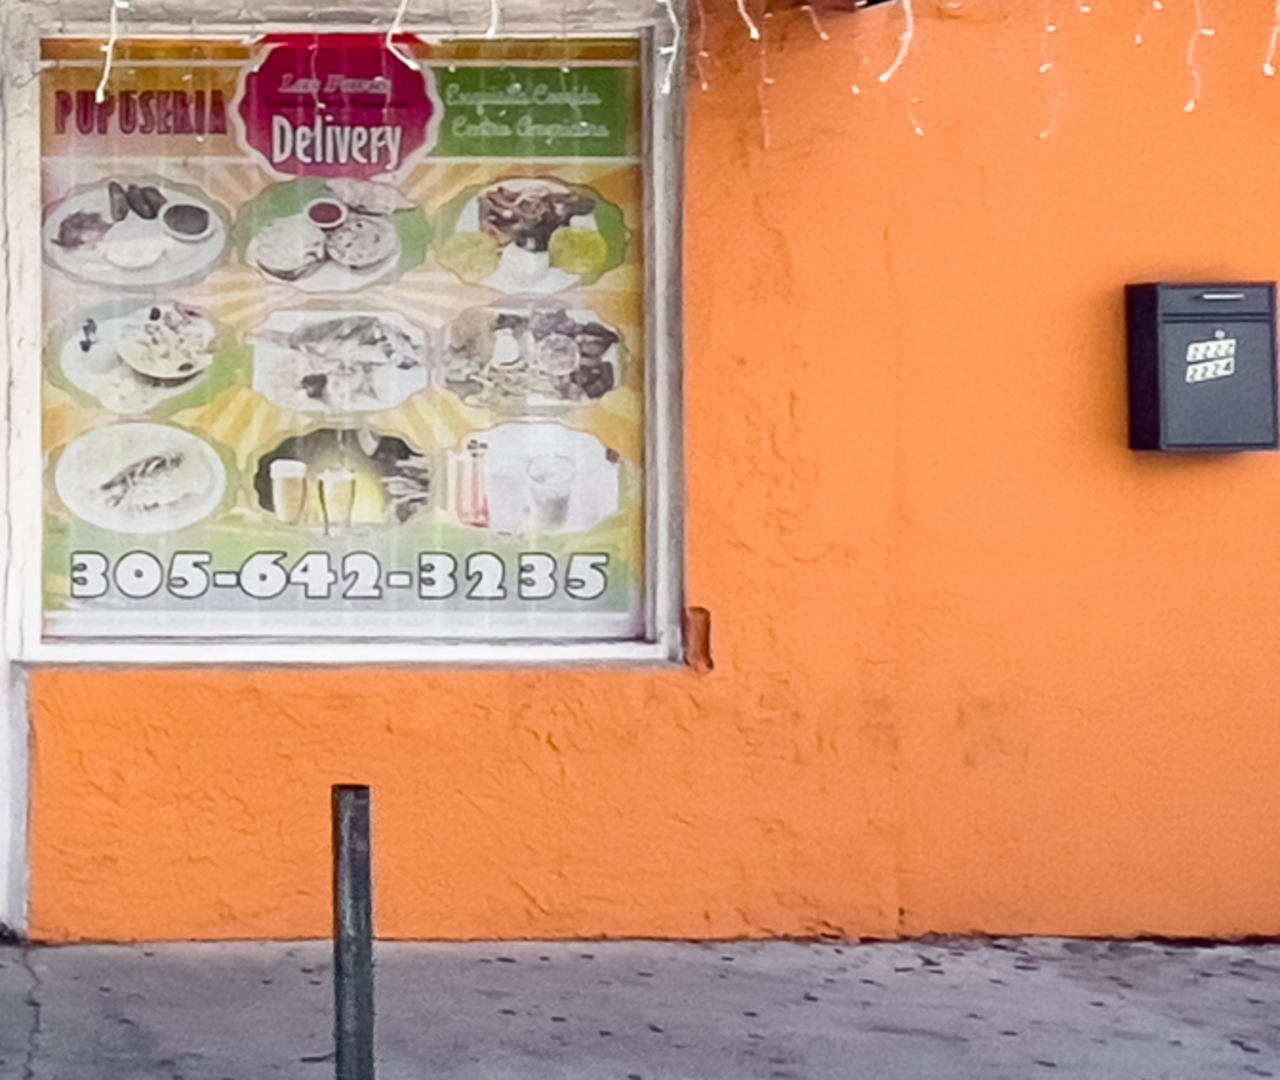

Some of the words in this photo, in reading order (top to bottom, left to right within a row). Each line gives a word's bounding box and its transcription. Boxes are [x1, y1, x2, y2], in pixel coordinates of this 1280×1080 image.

[55, 90, 227, 135] PUPUSERIA
[272, 115, 402, 168] Delivery
[70, 551, 610, 601] 305-642-3235
